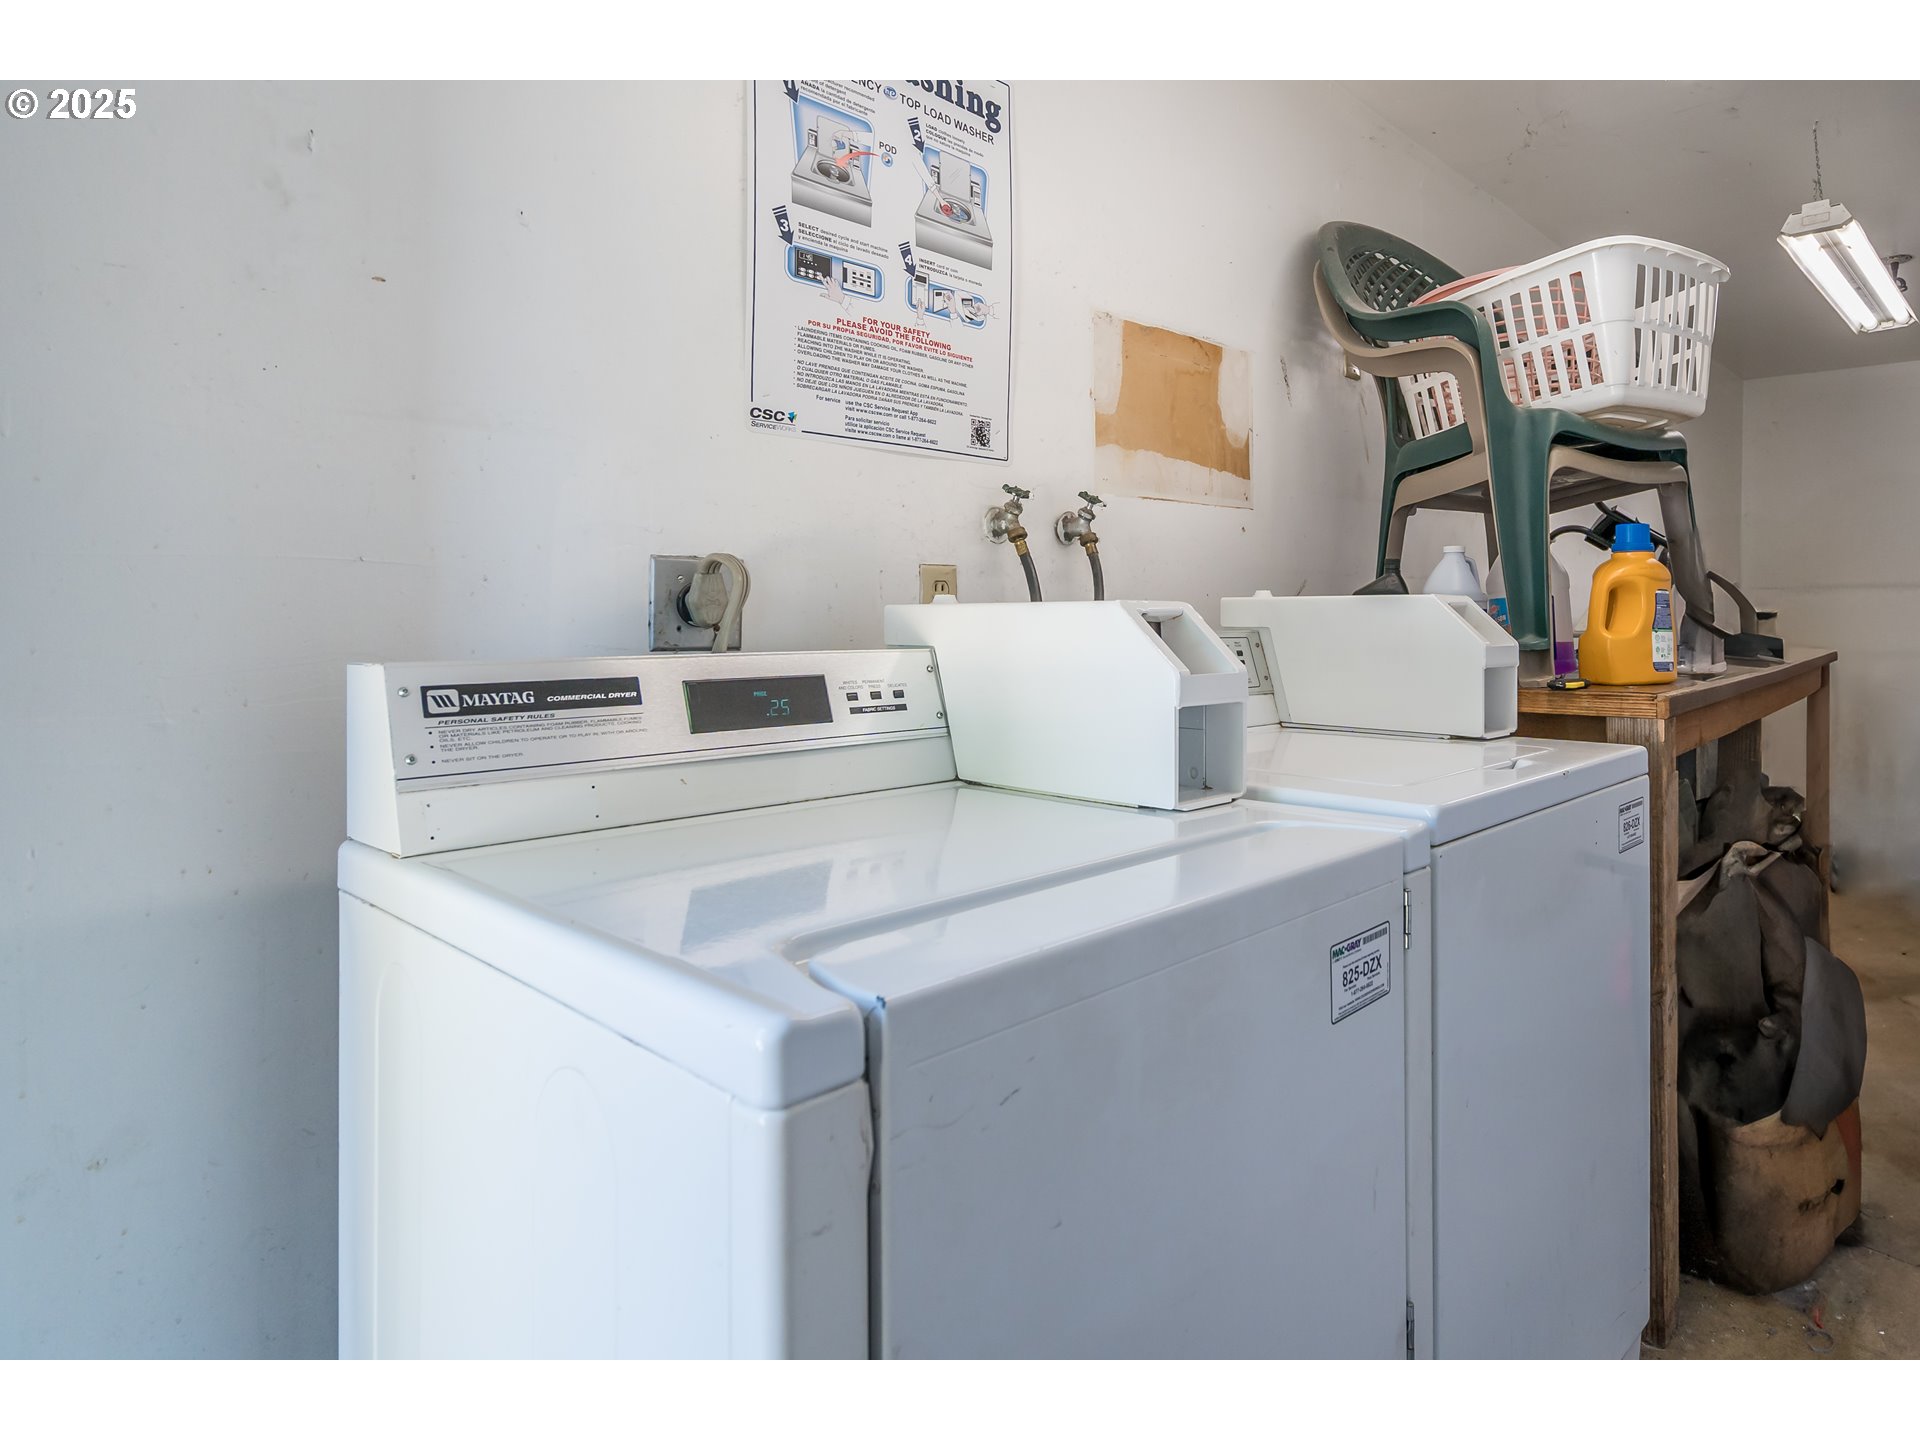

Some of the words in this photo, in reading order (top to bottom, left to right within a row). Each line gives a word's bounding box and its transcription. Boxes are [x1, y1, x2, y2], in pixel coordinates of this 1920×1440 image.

[900, 94, 921, 110] TOP
[924, 105, 952, 125] LOAD
[954, 118, 994, 145] WASHER
[926, 123, 937, 132] LOAD
[914, 129, 921, 141] 2
[879, 141, 897, 155] POD
[780, 219, 789, 232] 3
[798, 228, 832, 242] SELECCIONE
[798, 221, 818, 232] SELECT
[821, 228, 837, 238] desired
[838, 234, 849, 242] cycle
[870, 244, 888, 253] machine
[905, 254, 912, 266] 4
[919, 258, 935, 266] INSERT
[919, 264, 948, 276] INTRODUZCA
[837, 318, 866, 331] PLEASE
[869, 325, 892, 337] AVOID
[896, 332, 909, 341] THE
[912, 336, 951, 351] FOLLOWING
[863, 317, 878, 326] FOR
[881, 321, 900, 332] YOUR
[903, 326, 930, 339] SAFETY
[833, 325, 854, 335] PROPIA
[905, 342, 922, 350] FAVOR
[750, 407, 785, 421] CSC
[462, 691, 535, 708] MAYTAG
[546, 694, 606, 702] COMMERCIAL
[766, 699, 790, 716] .25
[438, 716, 488, 726] PERSONAL
[491, 714, 526, 722] SAFETY
[1342, 954, 1382, 988] 825-DZX
